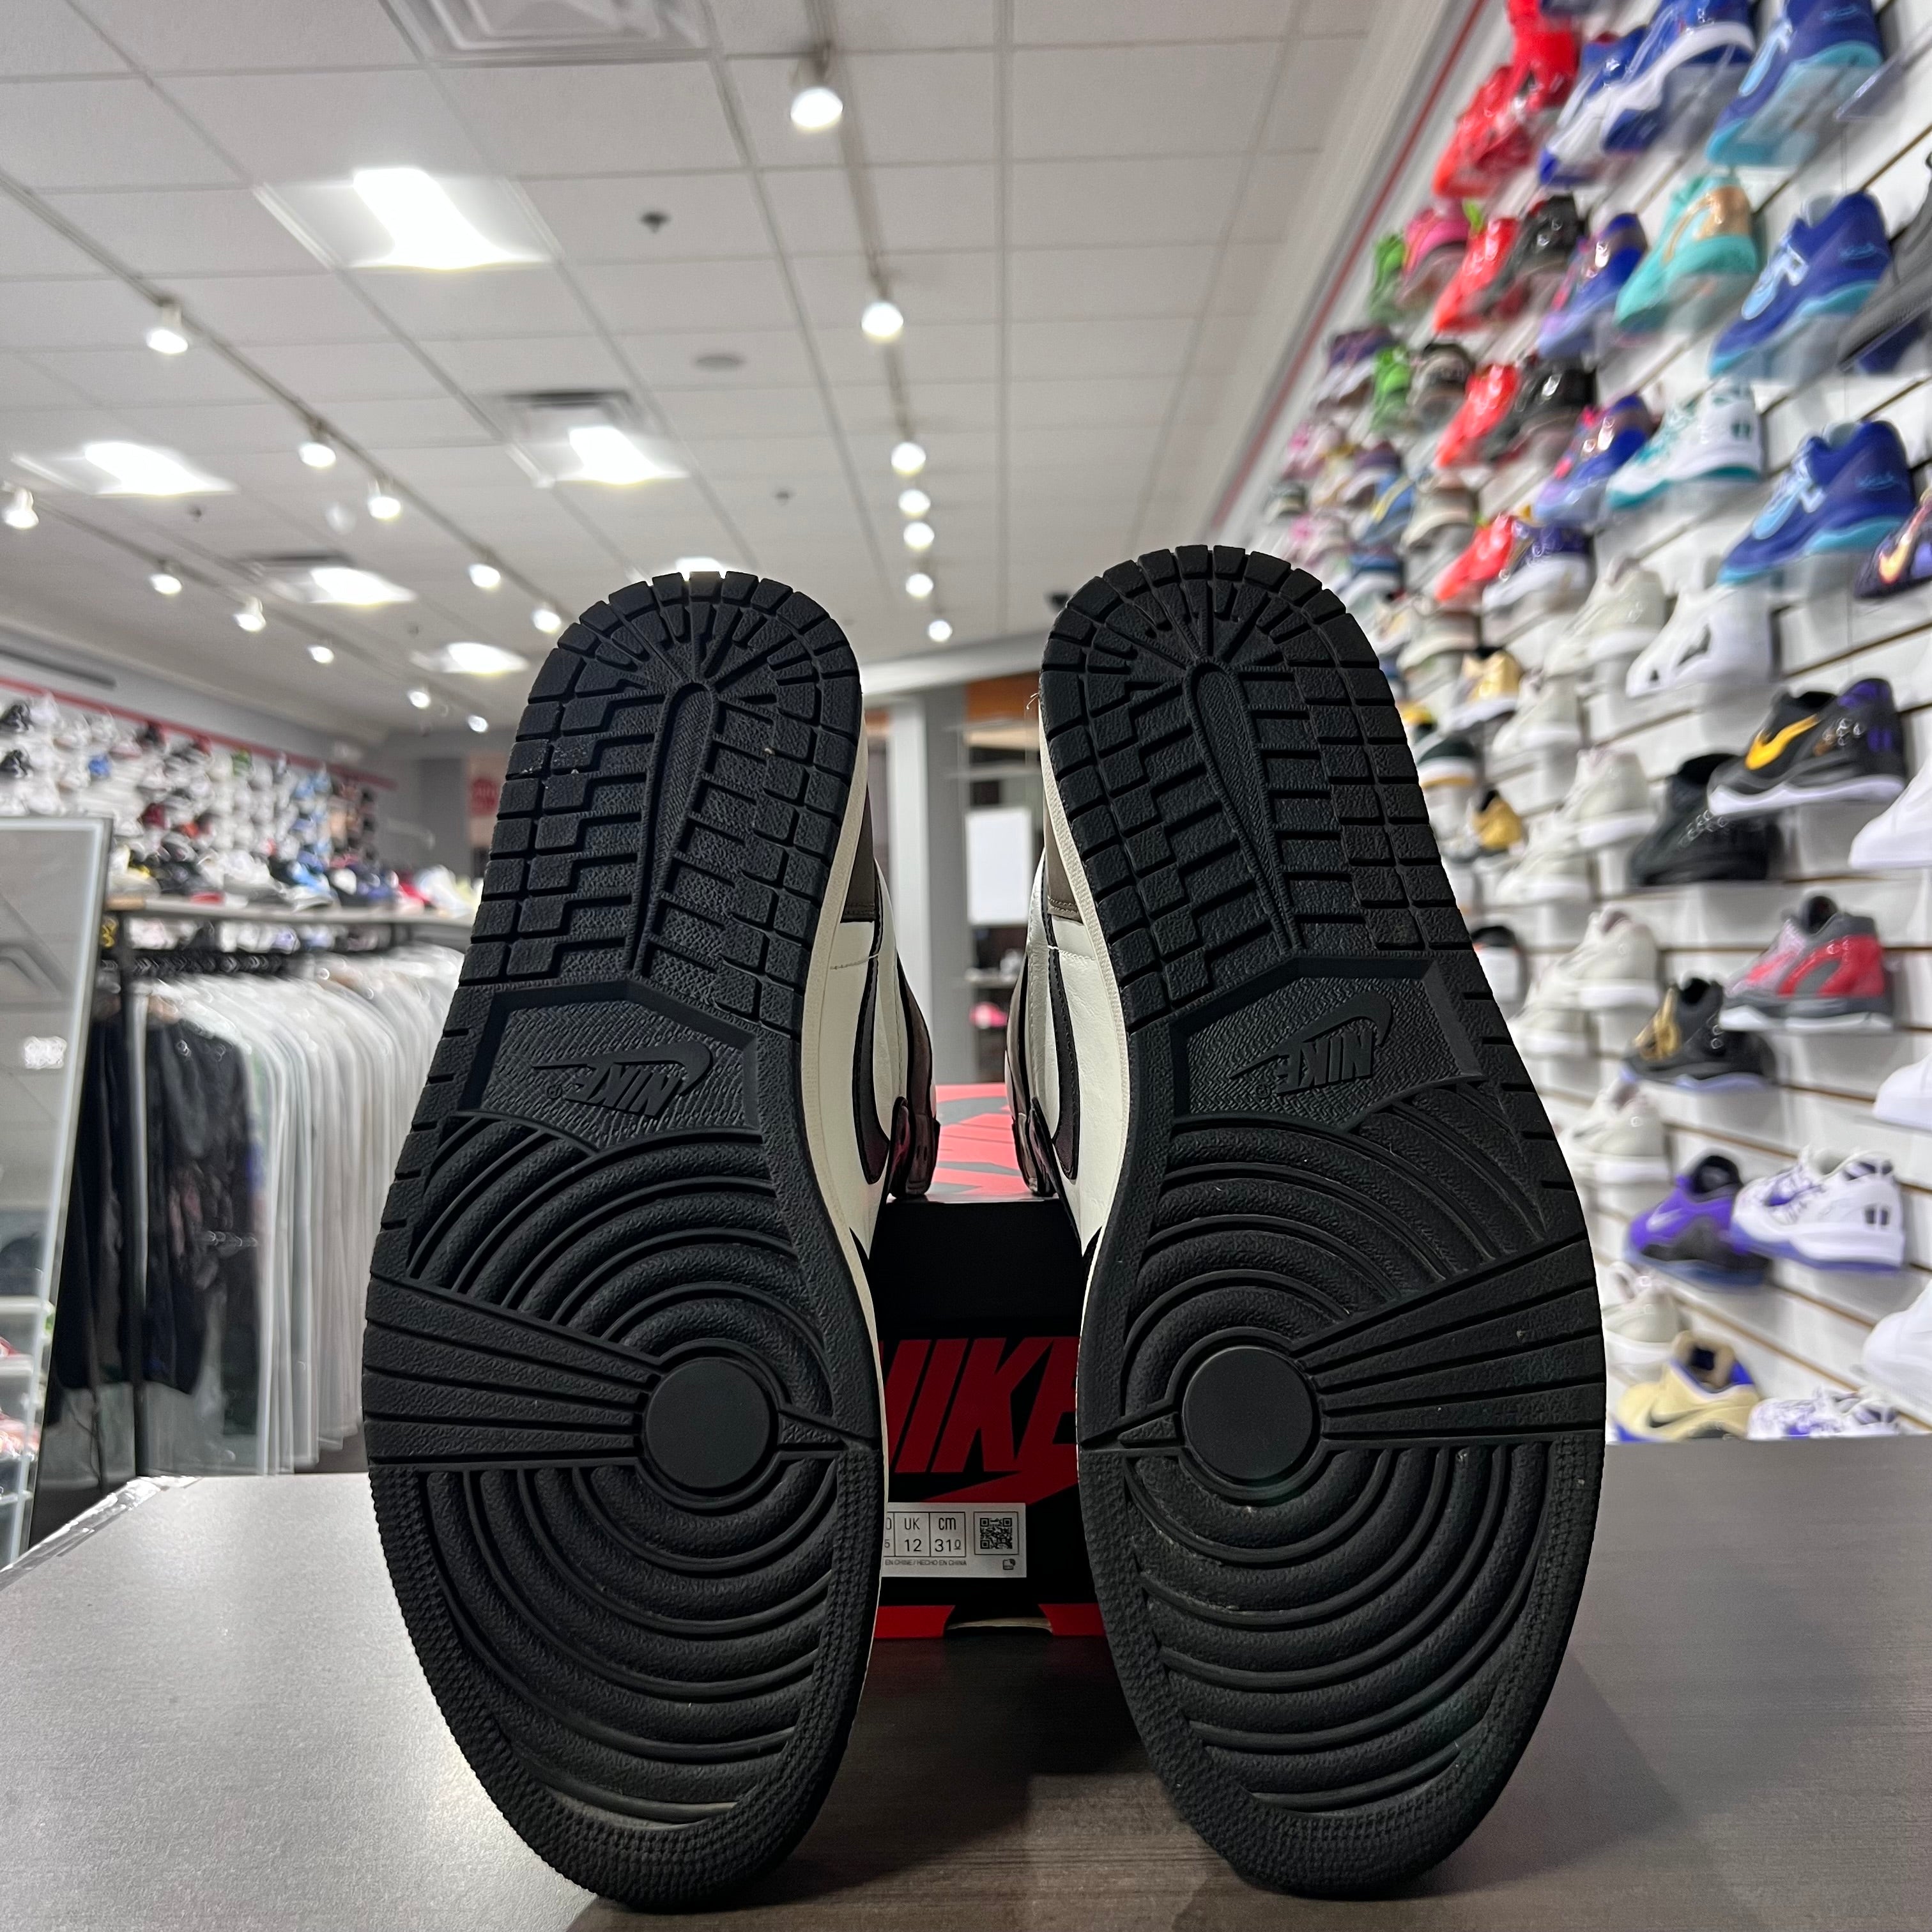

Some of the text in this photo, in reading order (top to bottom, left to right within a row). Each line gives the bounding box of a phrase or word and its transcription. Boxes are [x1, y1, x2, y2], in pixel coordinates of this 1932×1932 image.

[1277, 1029, 1374, 1097] NIKE
[565, 1062, 684, 1118] NIKE
[904, 1517, 921, 1530] UK
[904, 1538, 922, 1552] 12
